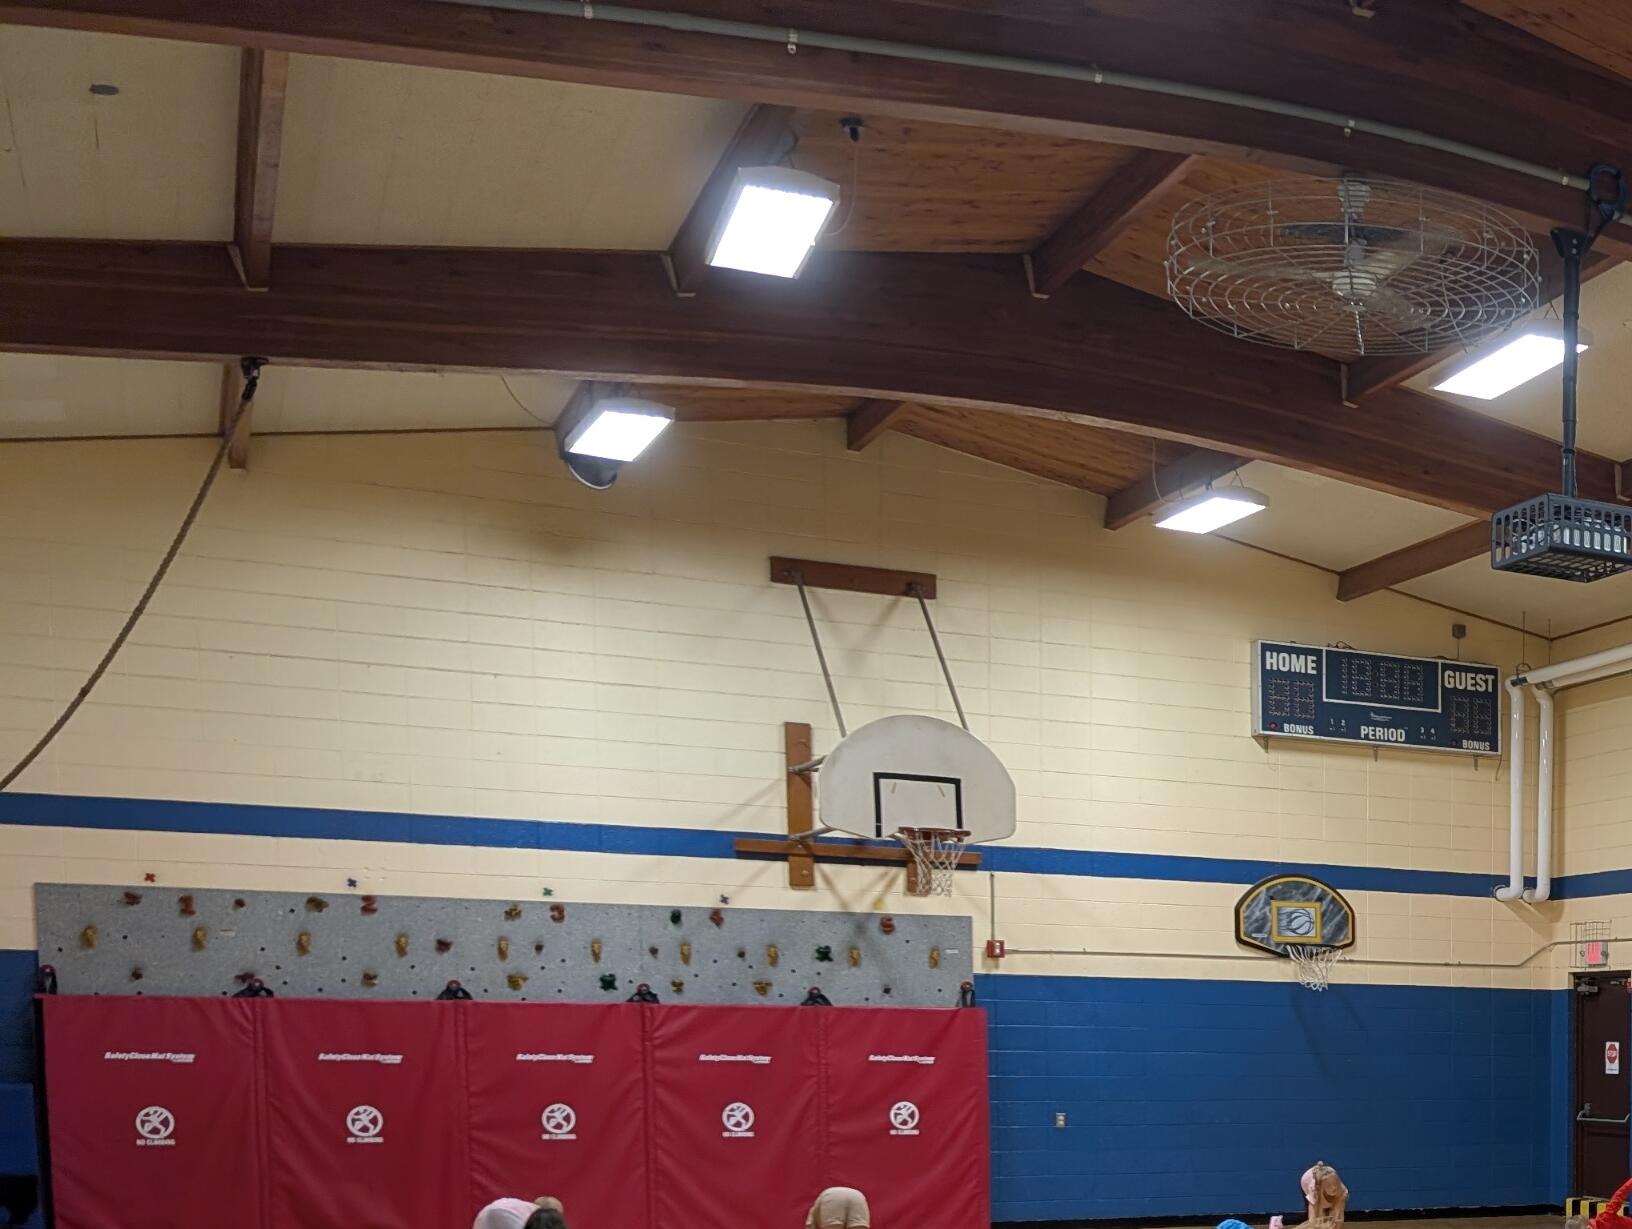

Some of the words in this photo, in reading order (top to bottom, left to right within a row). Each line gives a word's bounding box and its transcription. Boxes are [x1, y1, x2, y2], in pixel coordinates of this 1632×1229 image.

[1265, 651, 1317, 675] HOME
[1444, 670, 1495, 693] GUEST
[1283, 723, 1314, 735] BONUS
[1341, 719, 1346, 727] 2
[1360, 725, 1406, 742] PERIOD
[1420, 726, 1425, 734] 3
[1462, 739, 1490, 751] BONUS
